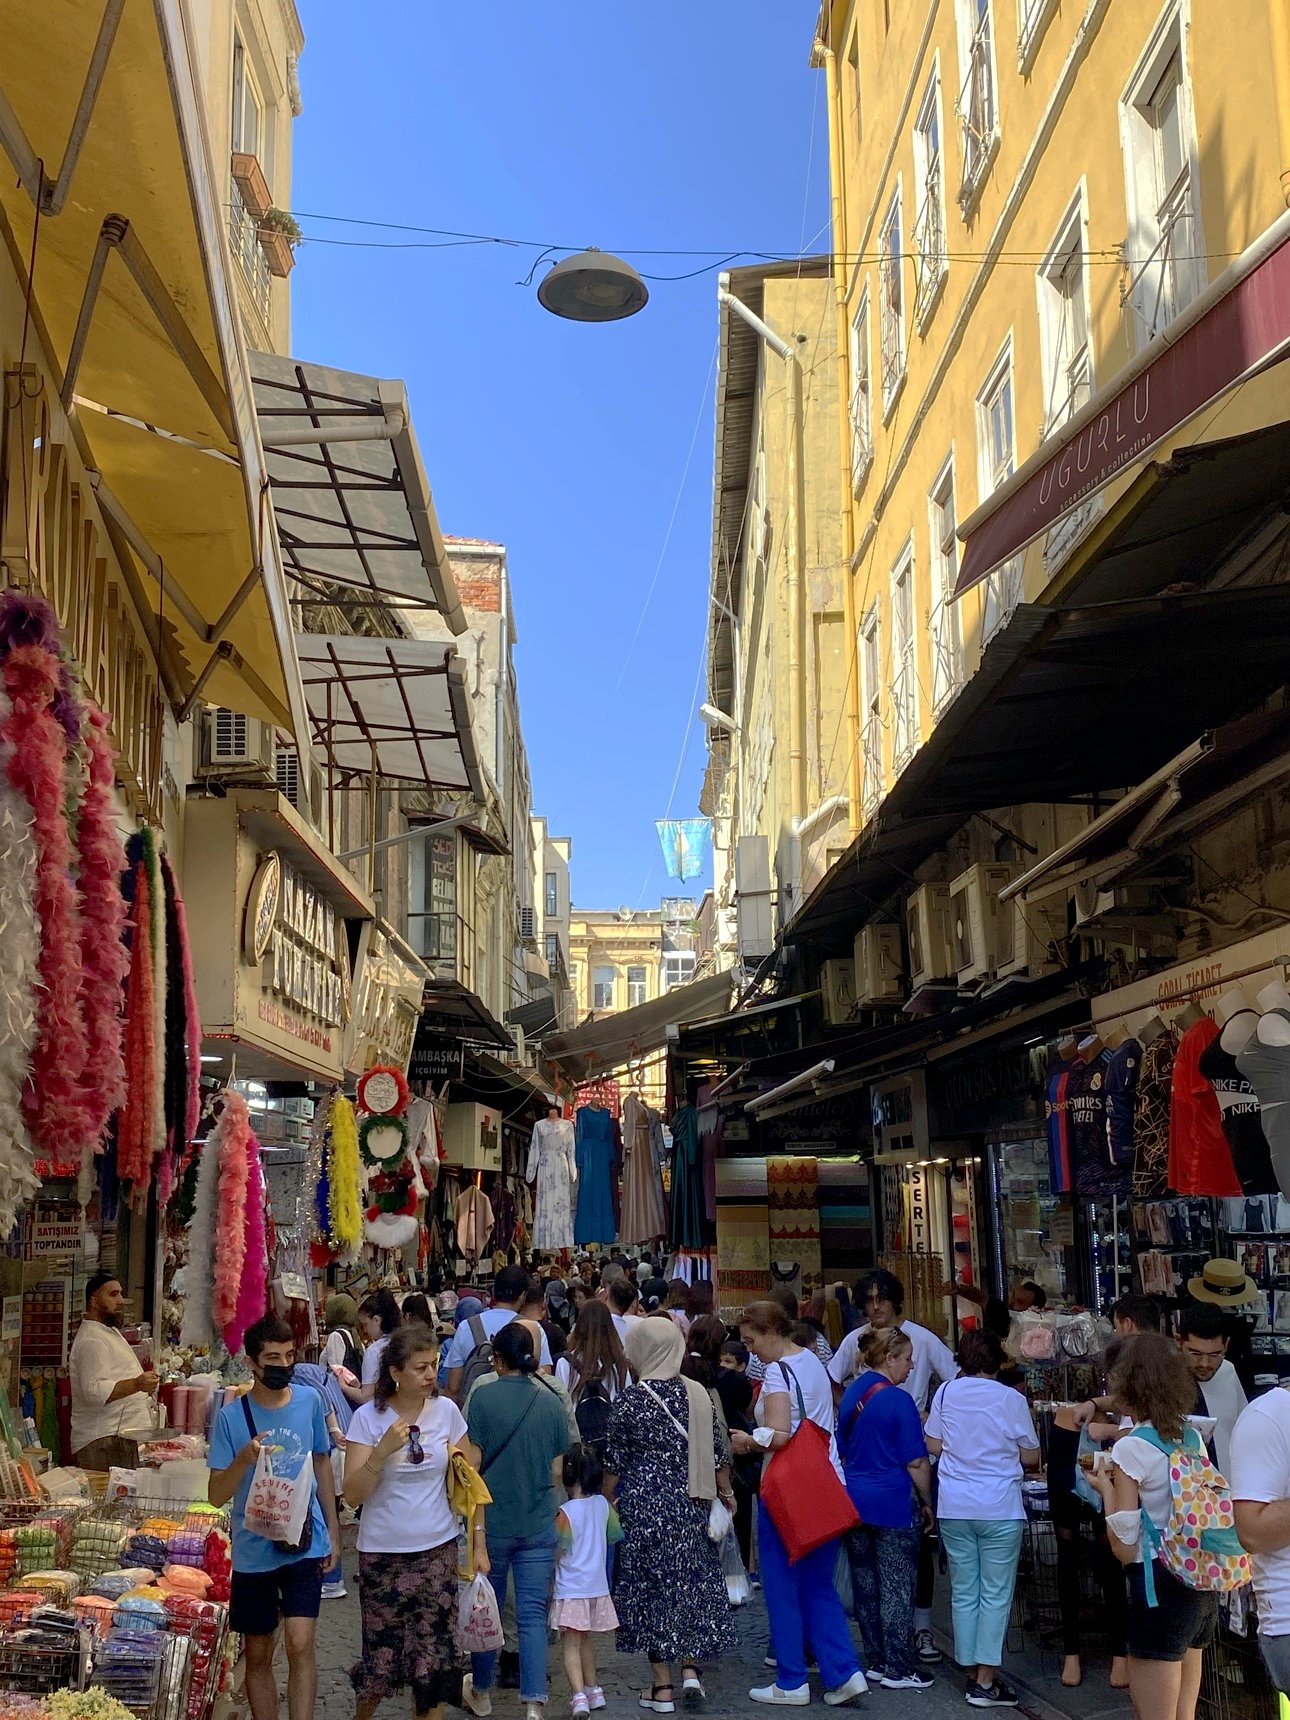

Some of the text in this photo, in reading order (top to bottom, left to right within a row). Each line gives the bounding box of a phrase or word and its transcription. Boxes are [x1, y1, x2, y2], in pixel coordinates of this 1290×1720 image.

[1059, 477, 1099, 513] accessory
[1107, 432, 1152, 473] collection
[283, 857, 335, 961] NAZAR
[1211, 1079, 1238, 1091] NIKE
[37, 1226, 79, 1238] SATIŞIMIZ
[34, 1240, 81, 1249] TOPTANDIR
